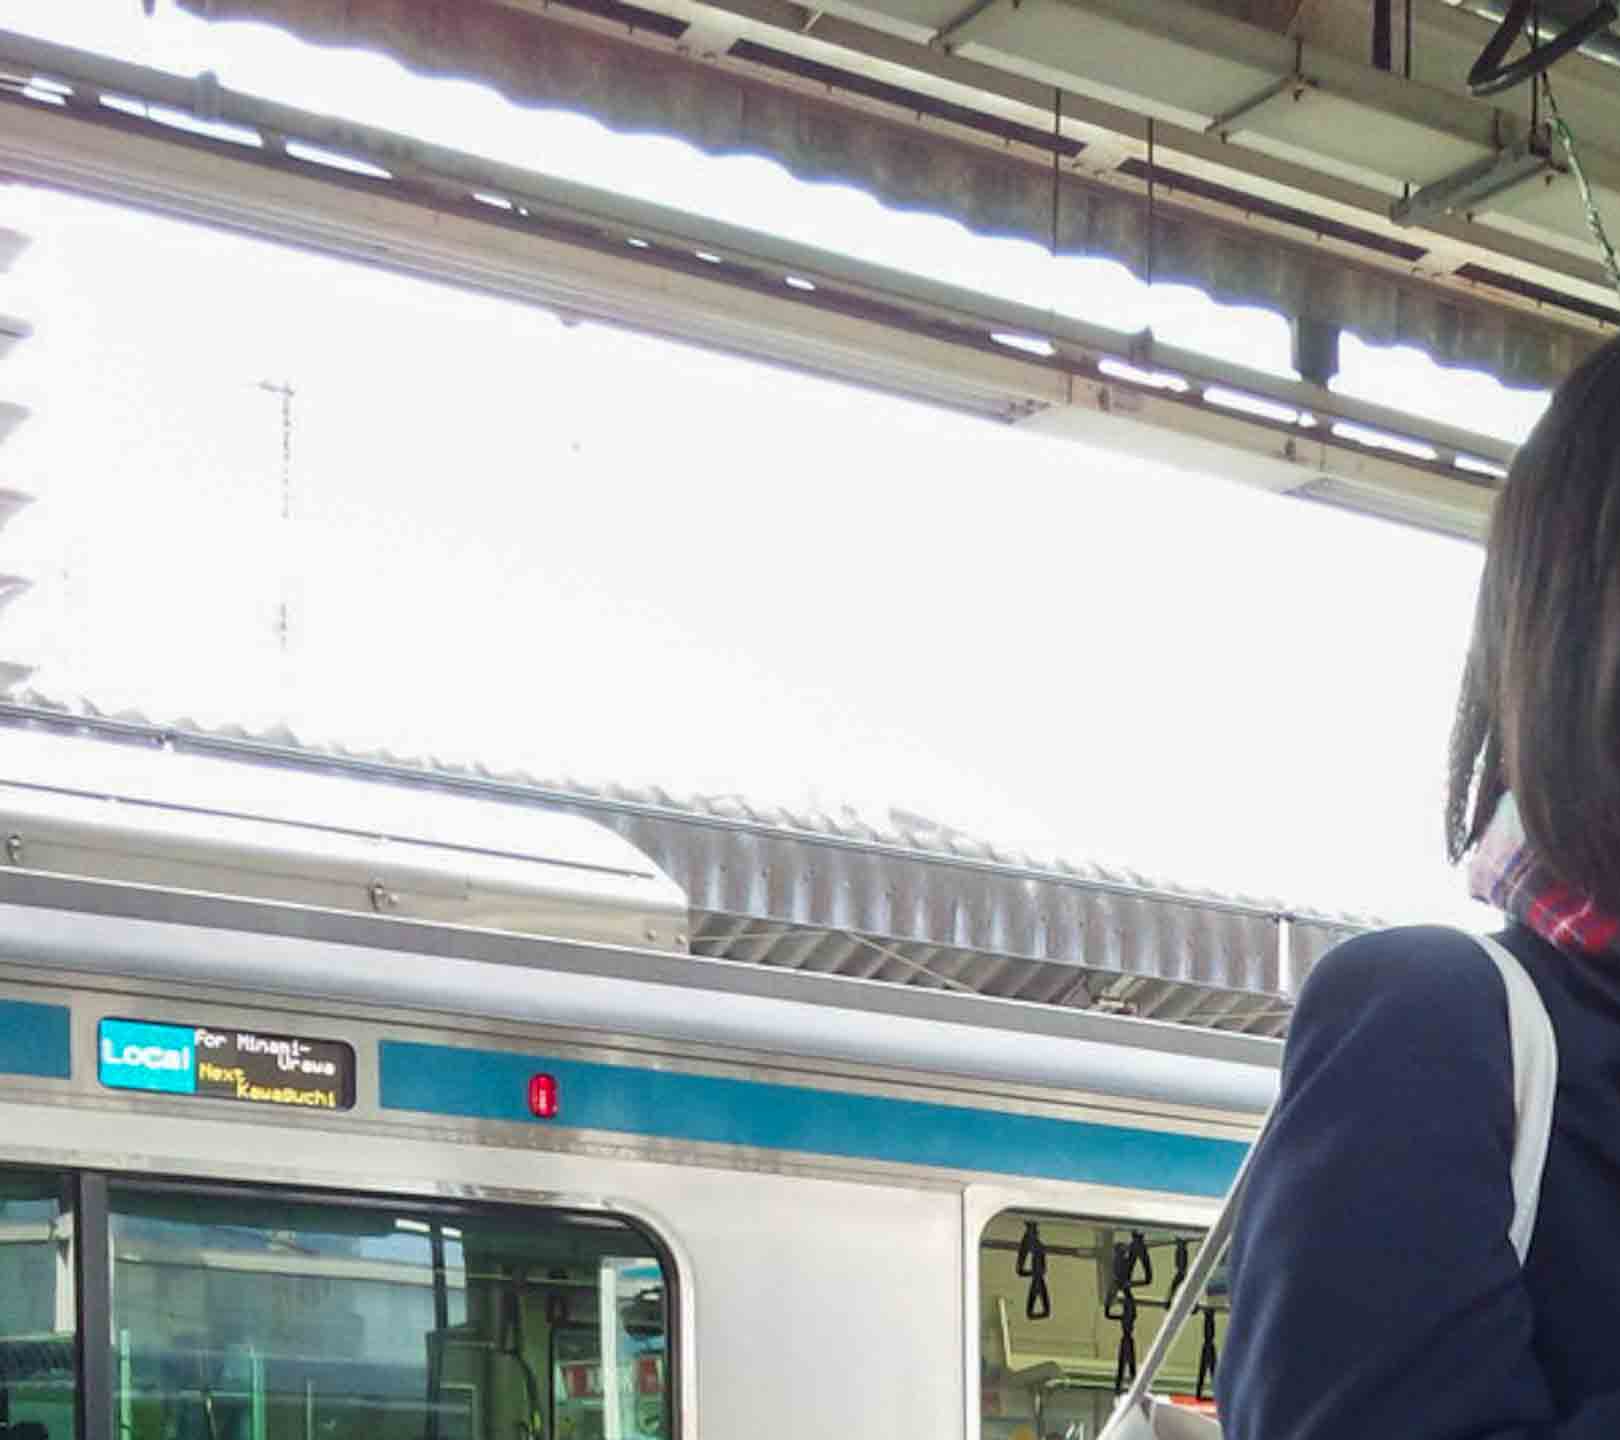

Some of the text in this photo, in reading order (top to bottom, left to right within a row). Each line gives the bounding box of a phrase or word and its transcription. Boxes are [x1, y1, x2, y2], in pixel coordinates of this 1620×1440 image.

[101, 1038, 190, 1071] Local
[277, 1054, 336, 1076] Urawa
[199, 1062, 244, 1082] Next
